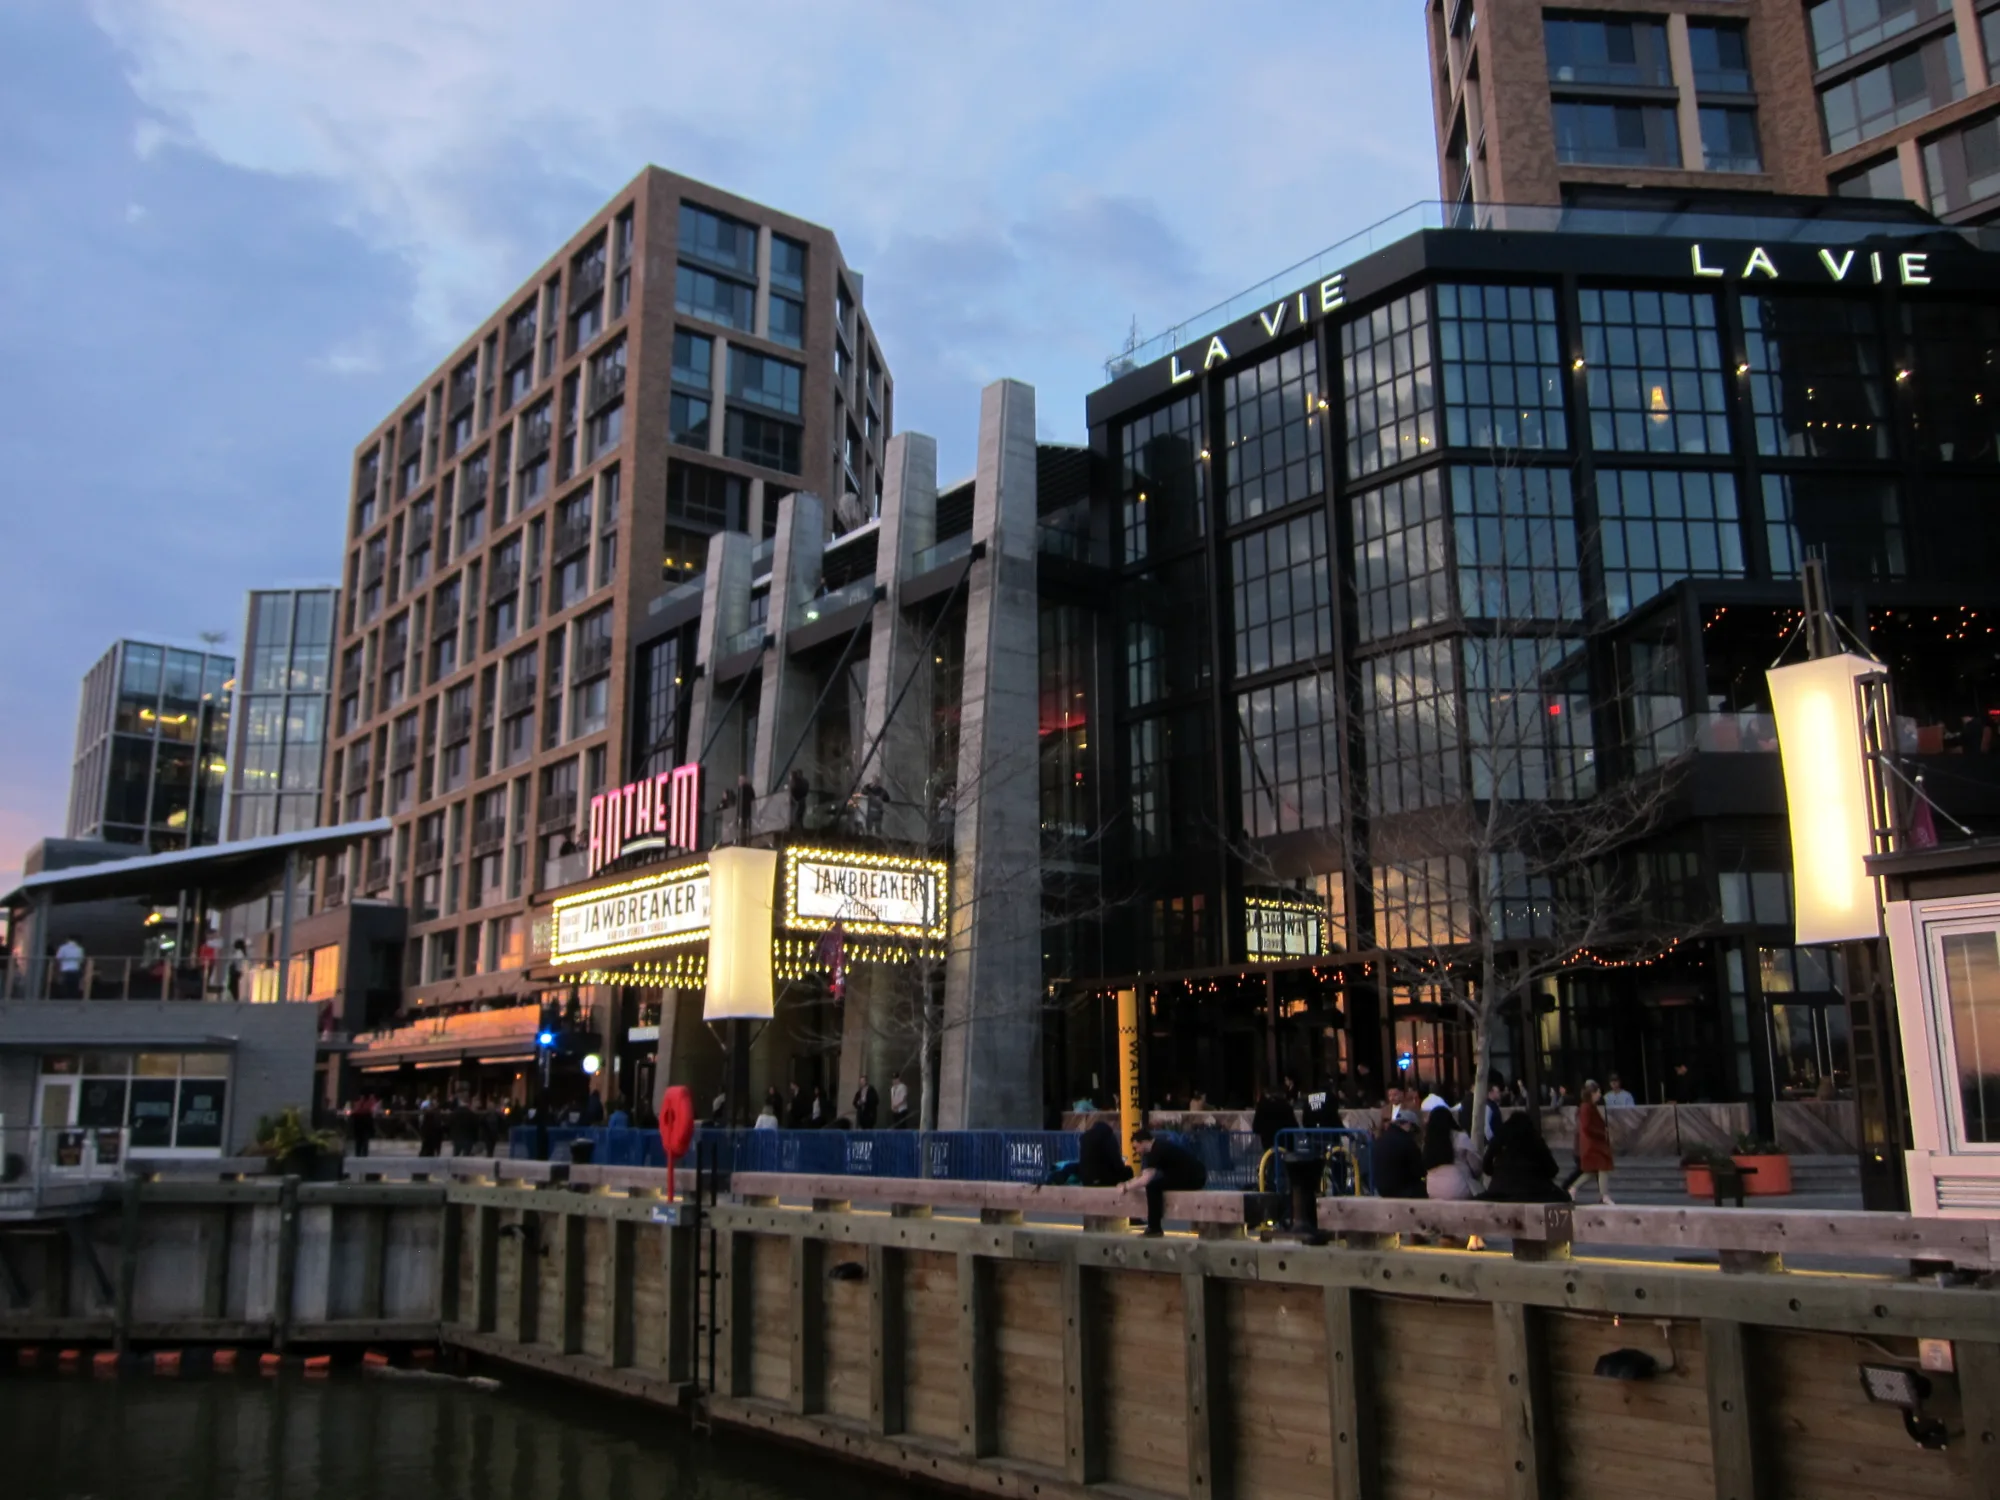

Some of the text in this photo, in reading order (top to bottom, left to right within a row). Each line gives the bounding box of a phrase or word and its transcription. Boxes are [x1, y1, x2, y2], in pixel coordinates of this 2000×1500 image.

[1691, 243, 1932, 286] LA VIE
[1170, 273, 1347, 384] LA VIE
[588, 761, 700, 878] ANTHEM
[584, 884, 697, 934] JAWBREAKER
[815, 866, 919, 902] JAWBREAKER
[1129, 1040, 1141, 1109] WATER
